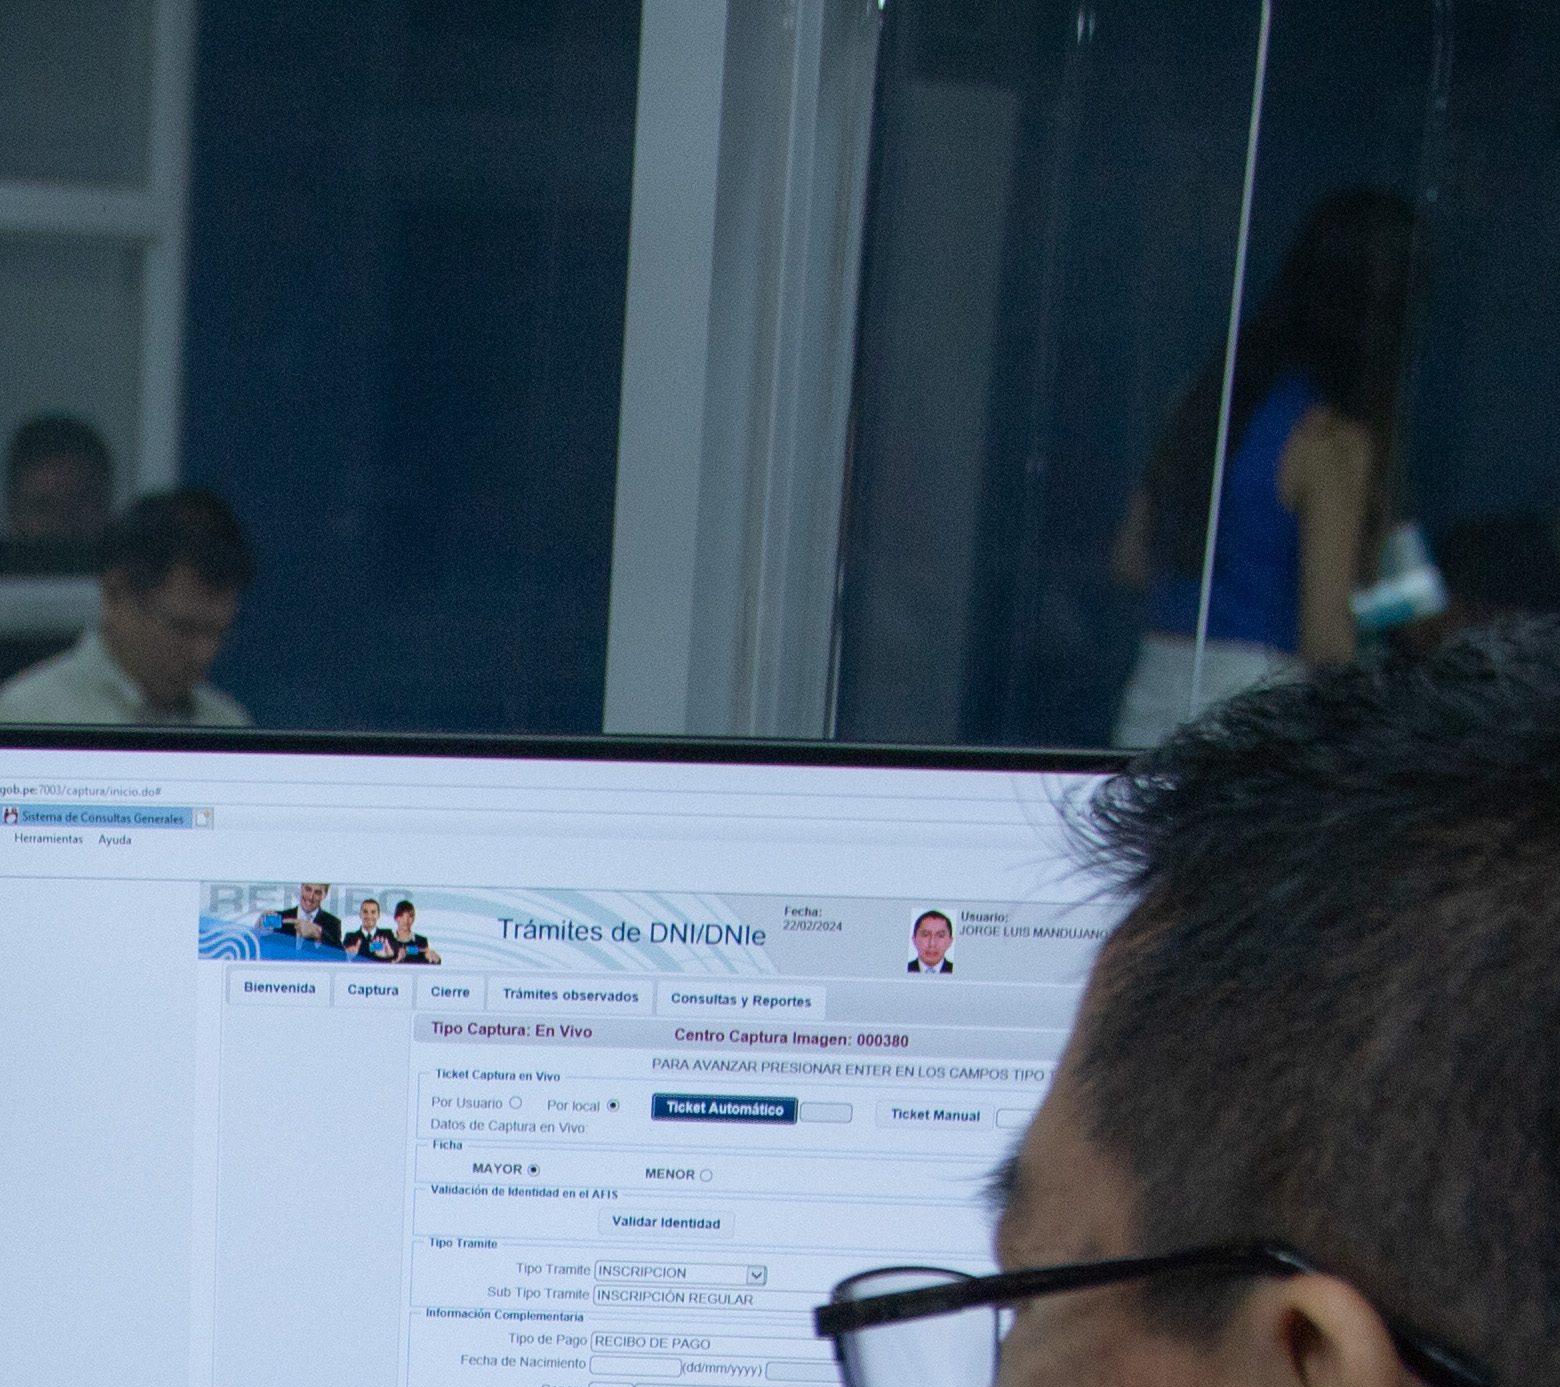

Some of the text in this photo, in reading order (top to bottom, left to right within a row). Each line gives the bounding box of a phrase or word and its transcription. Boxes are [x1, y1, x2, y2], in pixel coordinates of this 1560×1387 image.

[22, 811, 184, 825] Sistema de Consultas Generales
[14, 833, 83, 844] Herramientas
[98, 834, 132, 847] Ayuda
[784, 906, 823, 918] Fecha:
[961, 911, 1009, 923] Usuario:
[497, 917, 767, 946] Trámites de DNI/DNIe
[782, 920, 843, 932] 22/02/2024
[959, 926, 1000, 938] JORGE
[1003, 927, 1031, 938] LUIS
[243, 981, 316, 995] Bienvenida
[347, 984, 399, 998] Captura
[431, 986, 470, 998] Cierre
[503, 987, 639, 1002] Trámites observados
[671, 993, 812, 1009] Consultas y Reportes
[431, 1022, 593, 1039] Tipo Captura: En Vivo
[675, 1028, 909, 1048] Centro Captura Imagen: 000380
[436, 1069, 561, 1083] Ticket Captura en Vivo
[653, 1058, 689, 1071] PARA
[693, 1060, 757, 1073] AVANZAR
[761, 1062, 841, 1075] PRESIONAR
[845, 1064, 891, 1076] ENTER
[895, 1065, 914, 1077] EN
[918, 1066, 946, 1078] LOS
[949, 1067, 1008, 1080] CAMPOS
[1012, 1069, 1045, 1081] TIPO
[431, 1097, 503, 1109] Por Usuario
[547, 1100, 600, 1112] Por local
[667, 1100, 785, 1116] Ticket Automático
[892, 1108, 981, 1122] Ticket Manual
[431, 1119, 466, 1131] Datos
[469, 1120, 484, 1131] de
[488, 1121, 536, 1134] Captura
[540, 1124, 555, 1133] en
[432, 1140, 463, 1150] Ficha
[472, 1163, 523, 1175] MAYOR
[645, 1168, 695, 1180] MENOR
[431, 1184, 618, 1199] Validación de Identidad en el AFIS
[612, 1216, 721, 1230] Validar Identidad
[429, 1238, 498, 1250] Tipo Tramite
[517, 1263, 687, 1279] Tipo Tramite INSCRIPCION
[487, 1287, 754, 1306] Sub Tipo Tramite INSCRIPCIÓN REGULAR
[426, 1308, 584, 1324] Información Complementaria
[508, 1333, 711, 1350] Tipo de Pago RECIBO DE PAGO
[461, 1355, 763, 1377] Fecha de Nacimiento (dd/mm/yyyy)
